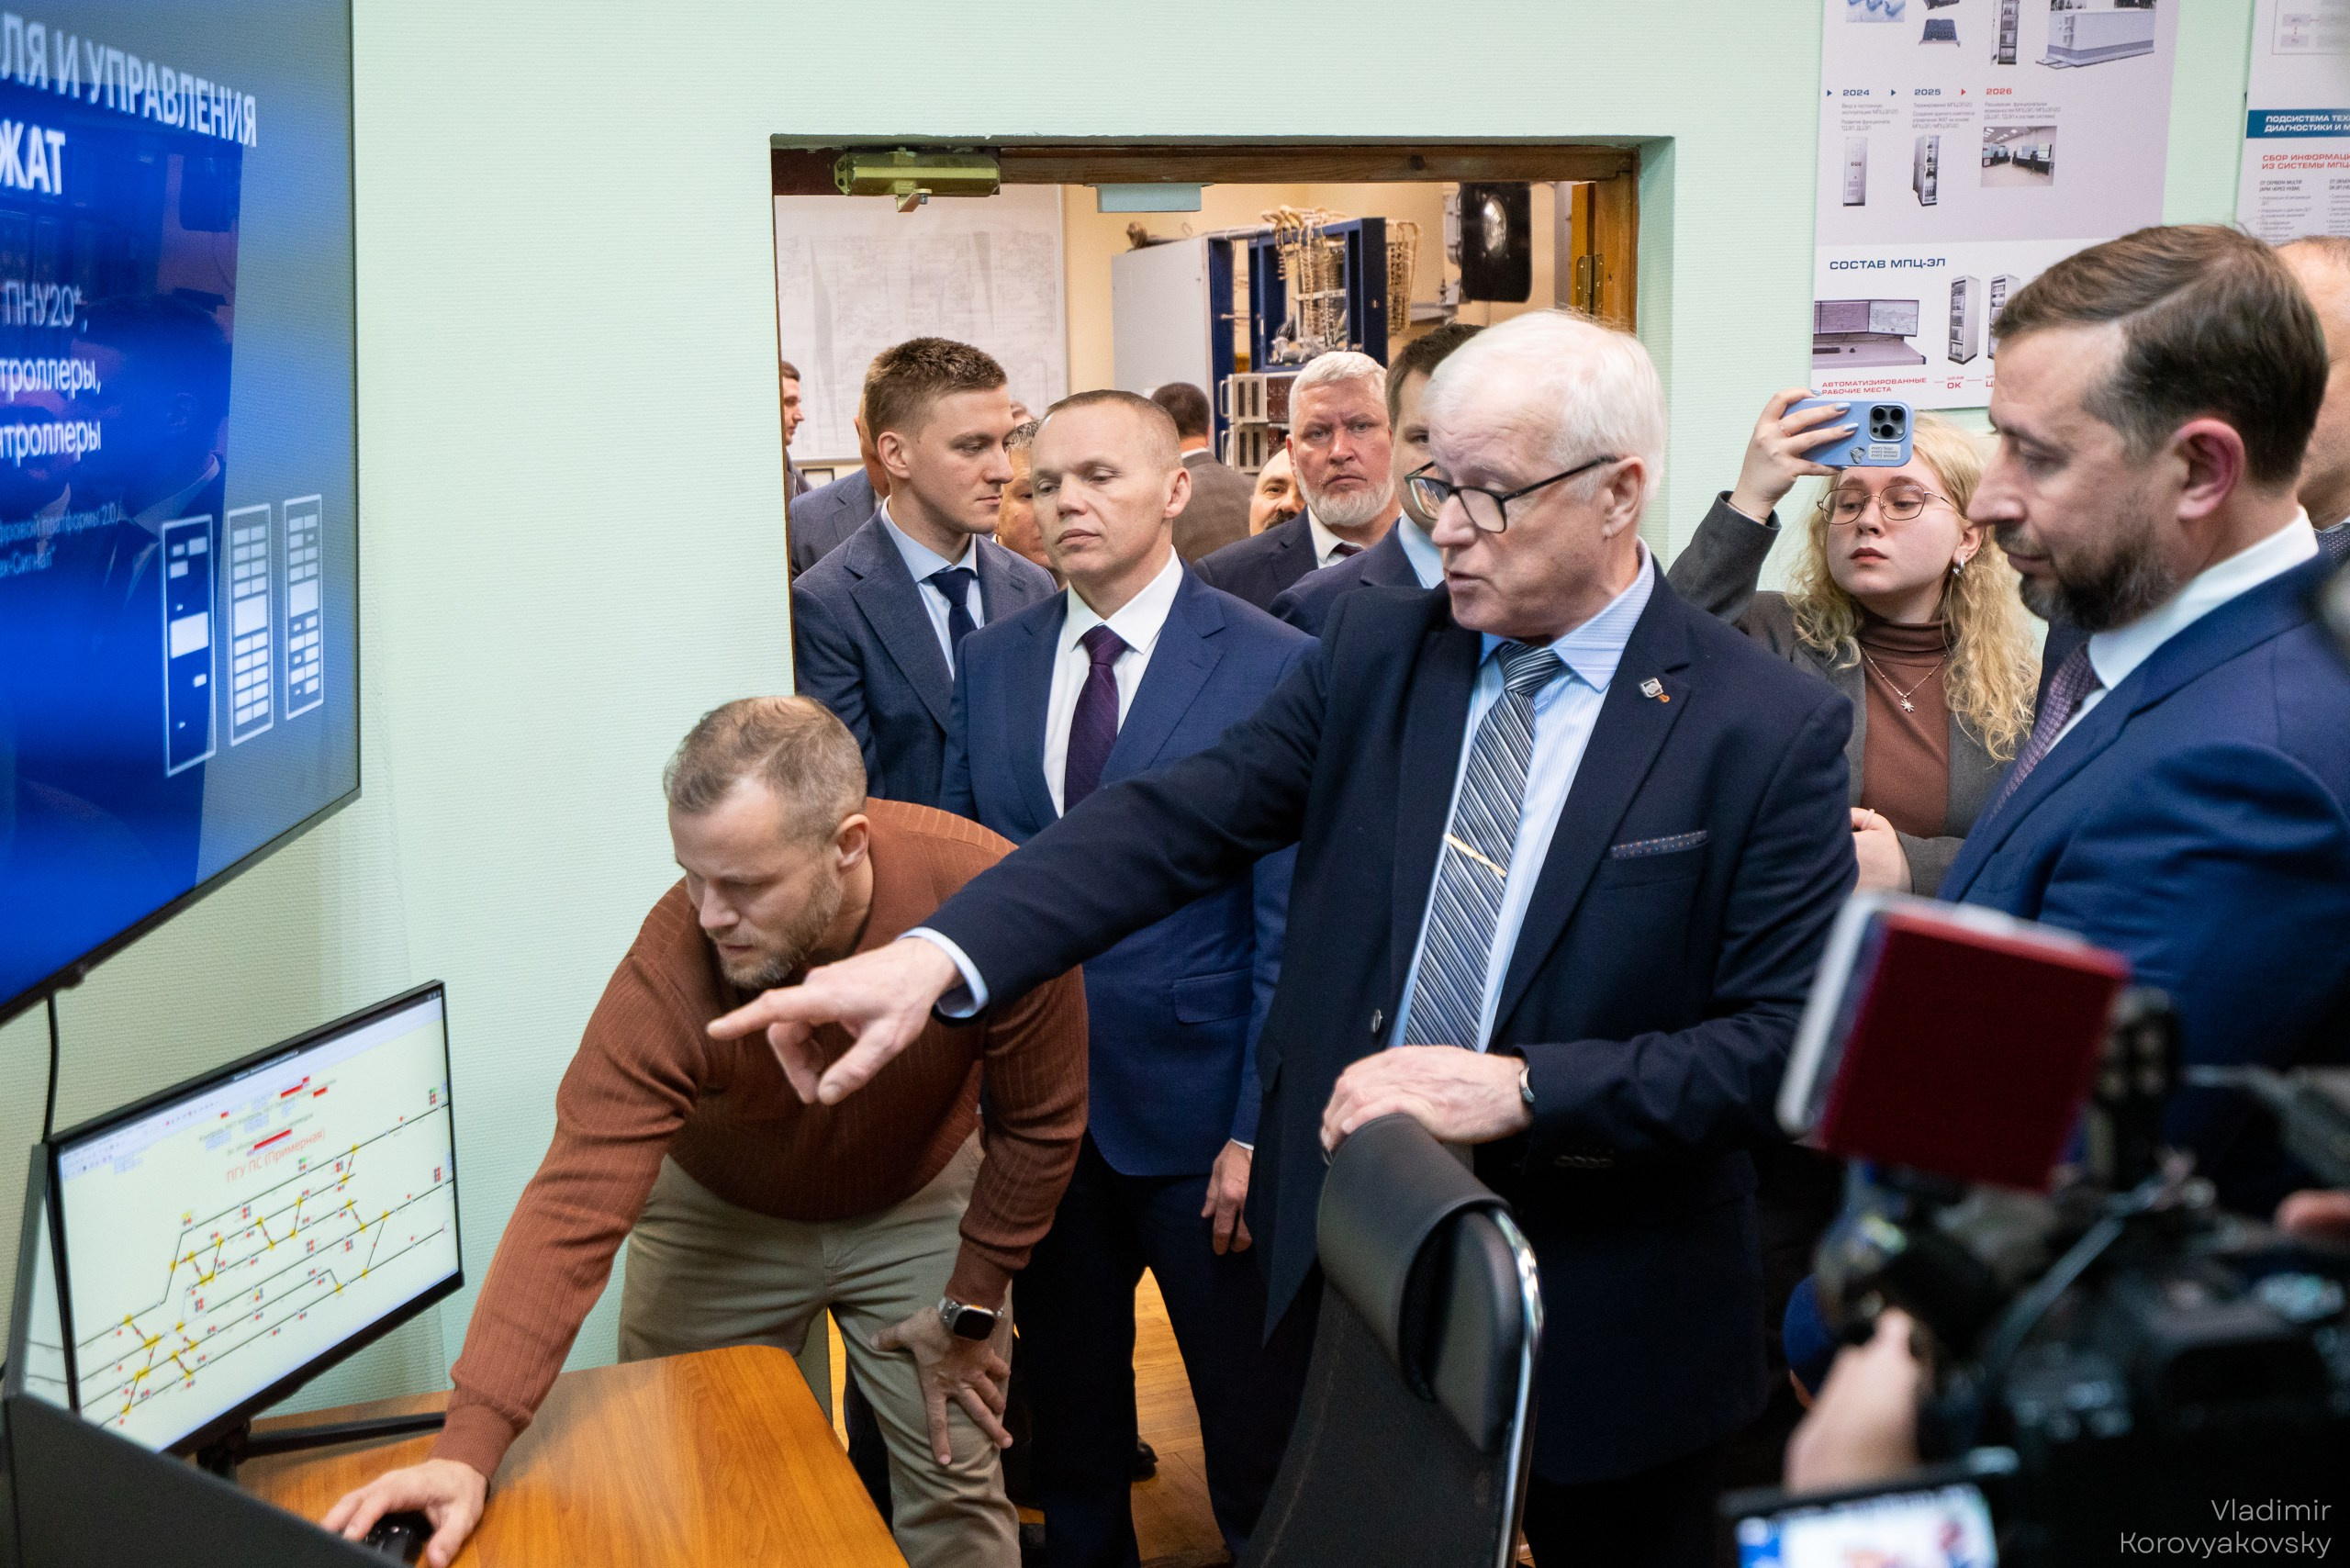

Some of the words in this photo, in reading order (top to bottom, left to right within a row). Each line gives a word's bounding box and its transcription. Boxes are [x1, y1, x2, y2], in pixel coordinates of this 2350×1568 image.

[56, 30, 80, 98] И
[86, 40, 257, 147] УПРАВЛЕНИЯ
[1914, 88, 1942, 96] 2025
[2266, 115, 2330, 123] ПОДСИСТЕМА
[2265, 124, 2333, 133] ДИАГНОСТИКИ
[0, 119, 65, 196] ЖАТ
[1830, 260, 1886, 270] СОСТАВ
[1891, 258, 1946, 268] МПЦ-ЭЛ
[1822, 377, 1927, 386] АВТОМАТИЗИРОВАННЫЕ
[1947, 381, 1961, 389] ОК
